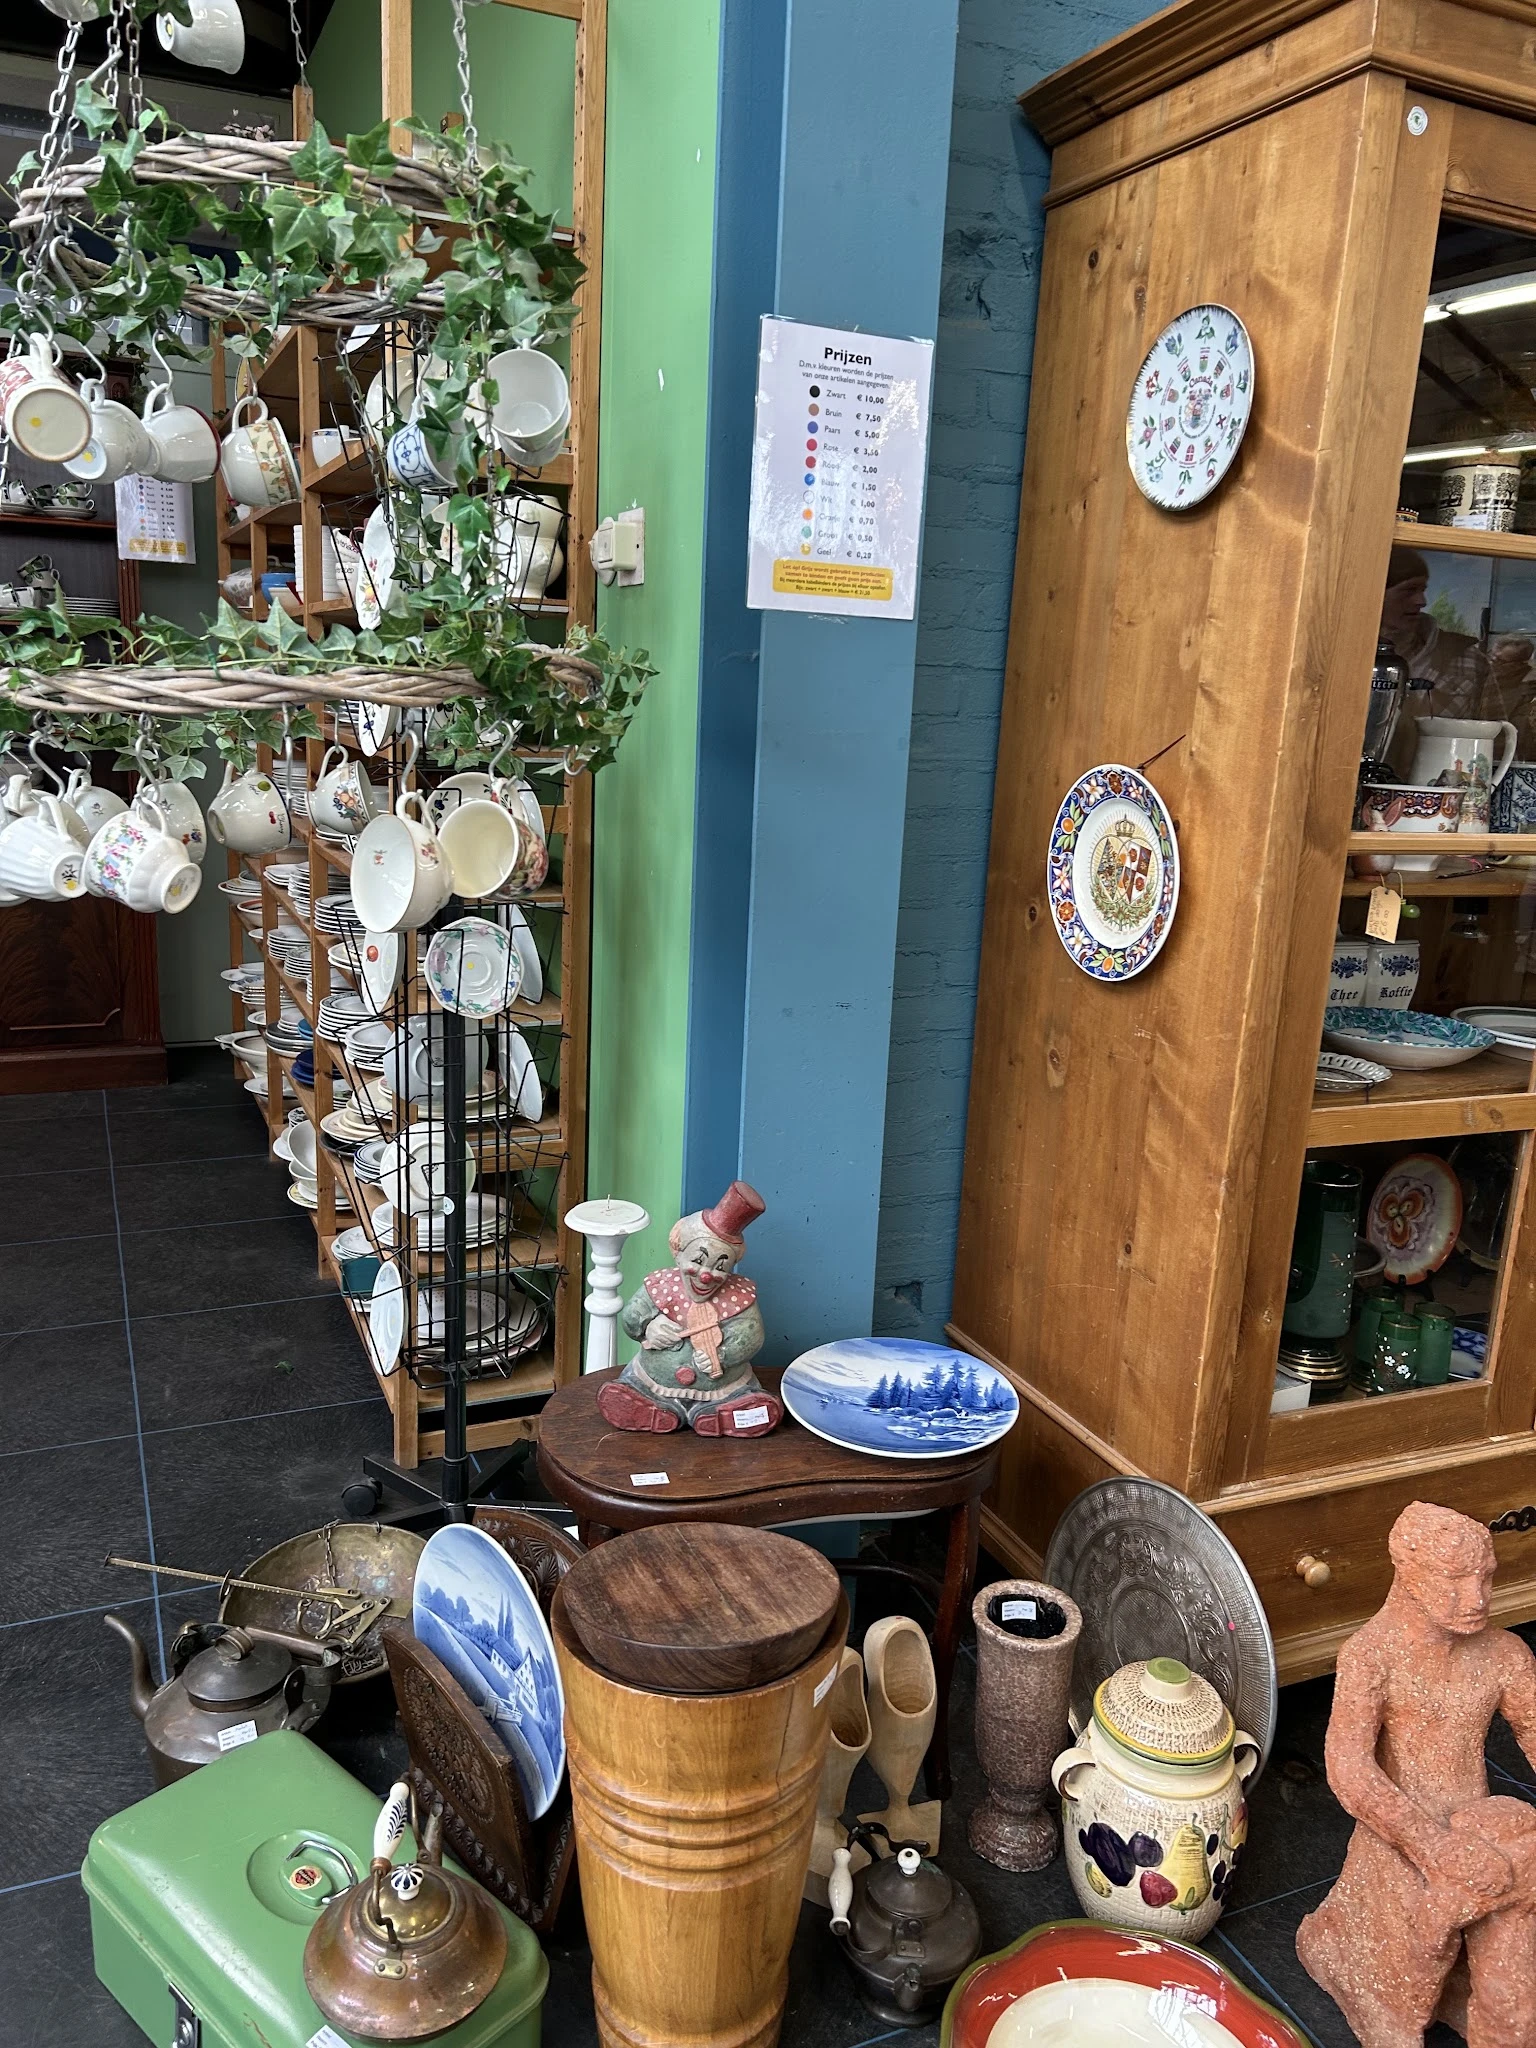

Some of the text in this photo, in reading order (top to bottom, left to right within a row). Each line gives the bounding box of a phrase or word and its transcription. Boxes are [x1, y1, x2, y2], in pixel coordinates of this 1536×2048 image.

[824, 347, 872, 366] Prijzen
[802, 371, 813, 379] van
[830, 374, 856, 384] artikelen
[818, 363, 841, 372] kleuren
[842, 367, 865, 376] worden
[874, 372, 894, 381] prijzen
[1189, 376, 1213, 388] Canada
[826, 389, 847, 400] Zwart
[865, 395, 884, 404] 10,00
[825, 408, 881, 423] Bruin € 7,50
[824, 425, 880, 439] Paars € 5,00
[863, 447, 879, 457] 3,50
[852, 464, 858, 472] €
[862, 465, 878, 474] 2,00
[851, 481, 857, 489] €
[861, 483, 877, 491] 1,50
[850, 498, 856, 506] €
[860, 499, 875, 508] 1,00
[848, 516, 854, 524] €
[858, 517, 874, 525] 0,70
[857, 534, 873, 543] 0,50
[816, 547, 832, 556] Geel
[1330, 988, 1358, 1003] Thee
[1378, 985, 1413, 1001] Koffie
